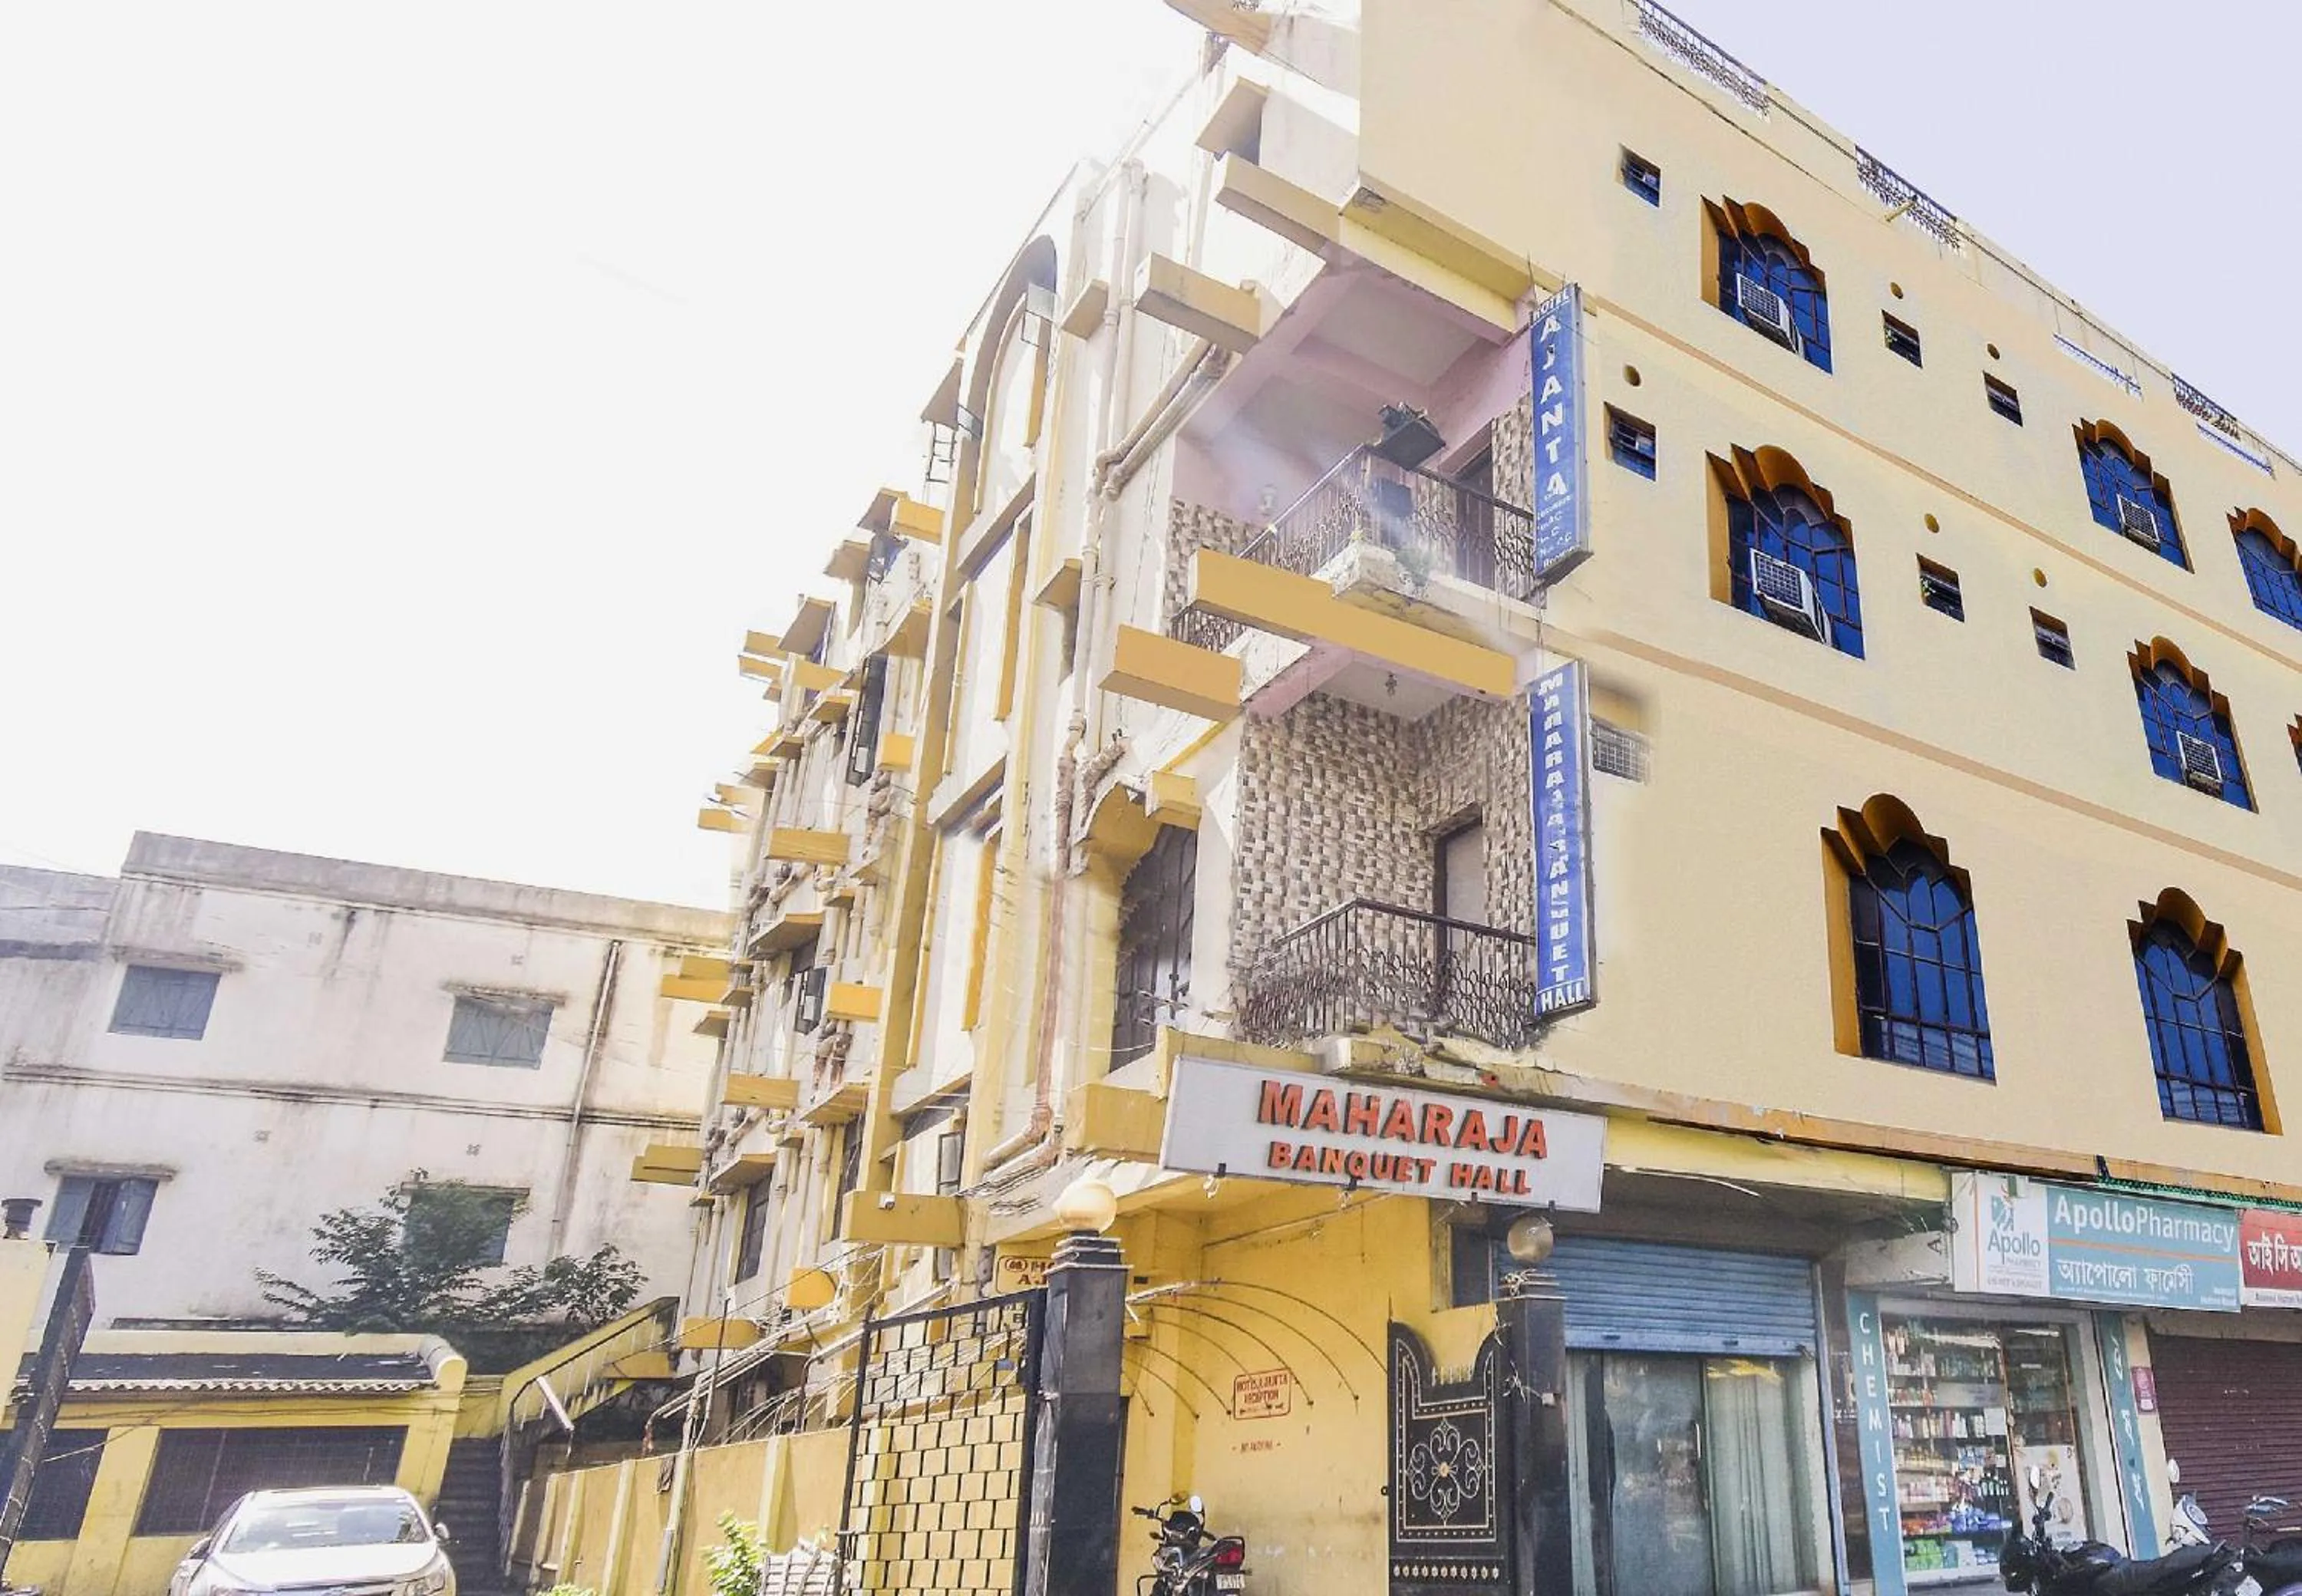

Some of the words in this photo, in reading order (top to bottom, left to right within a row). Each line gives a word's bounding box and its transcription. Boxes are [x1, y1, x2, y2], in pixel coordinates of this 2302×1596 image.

[1540, 315, 1568, 496] AJANTA
[1541, 981, 1585, 1013] HALL
[1258, 1080, 1548, 1159] MAHARAJA
[1267, 1140, 1437, 1184] BANQUET
[1449, 1162, 1532, 1195] HALL
[1987, 1228, 2041, 1265] Apollo
[1858, 1312, 1890, 1532] CHEMIST
